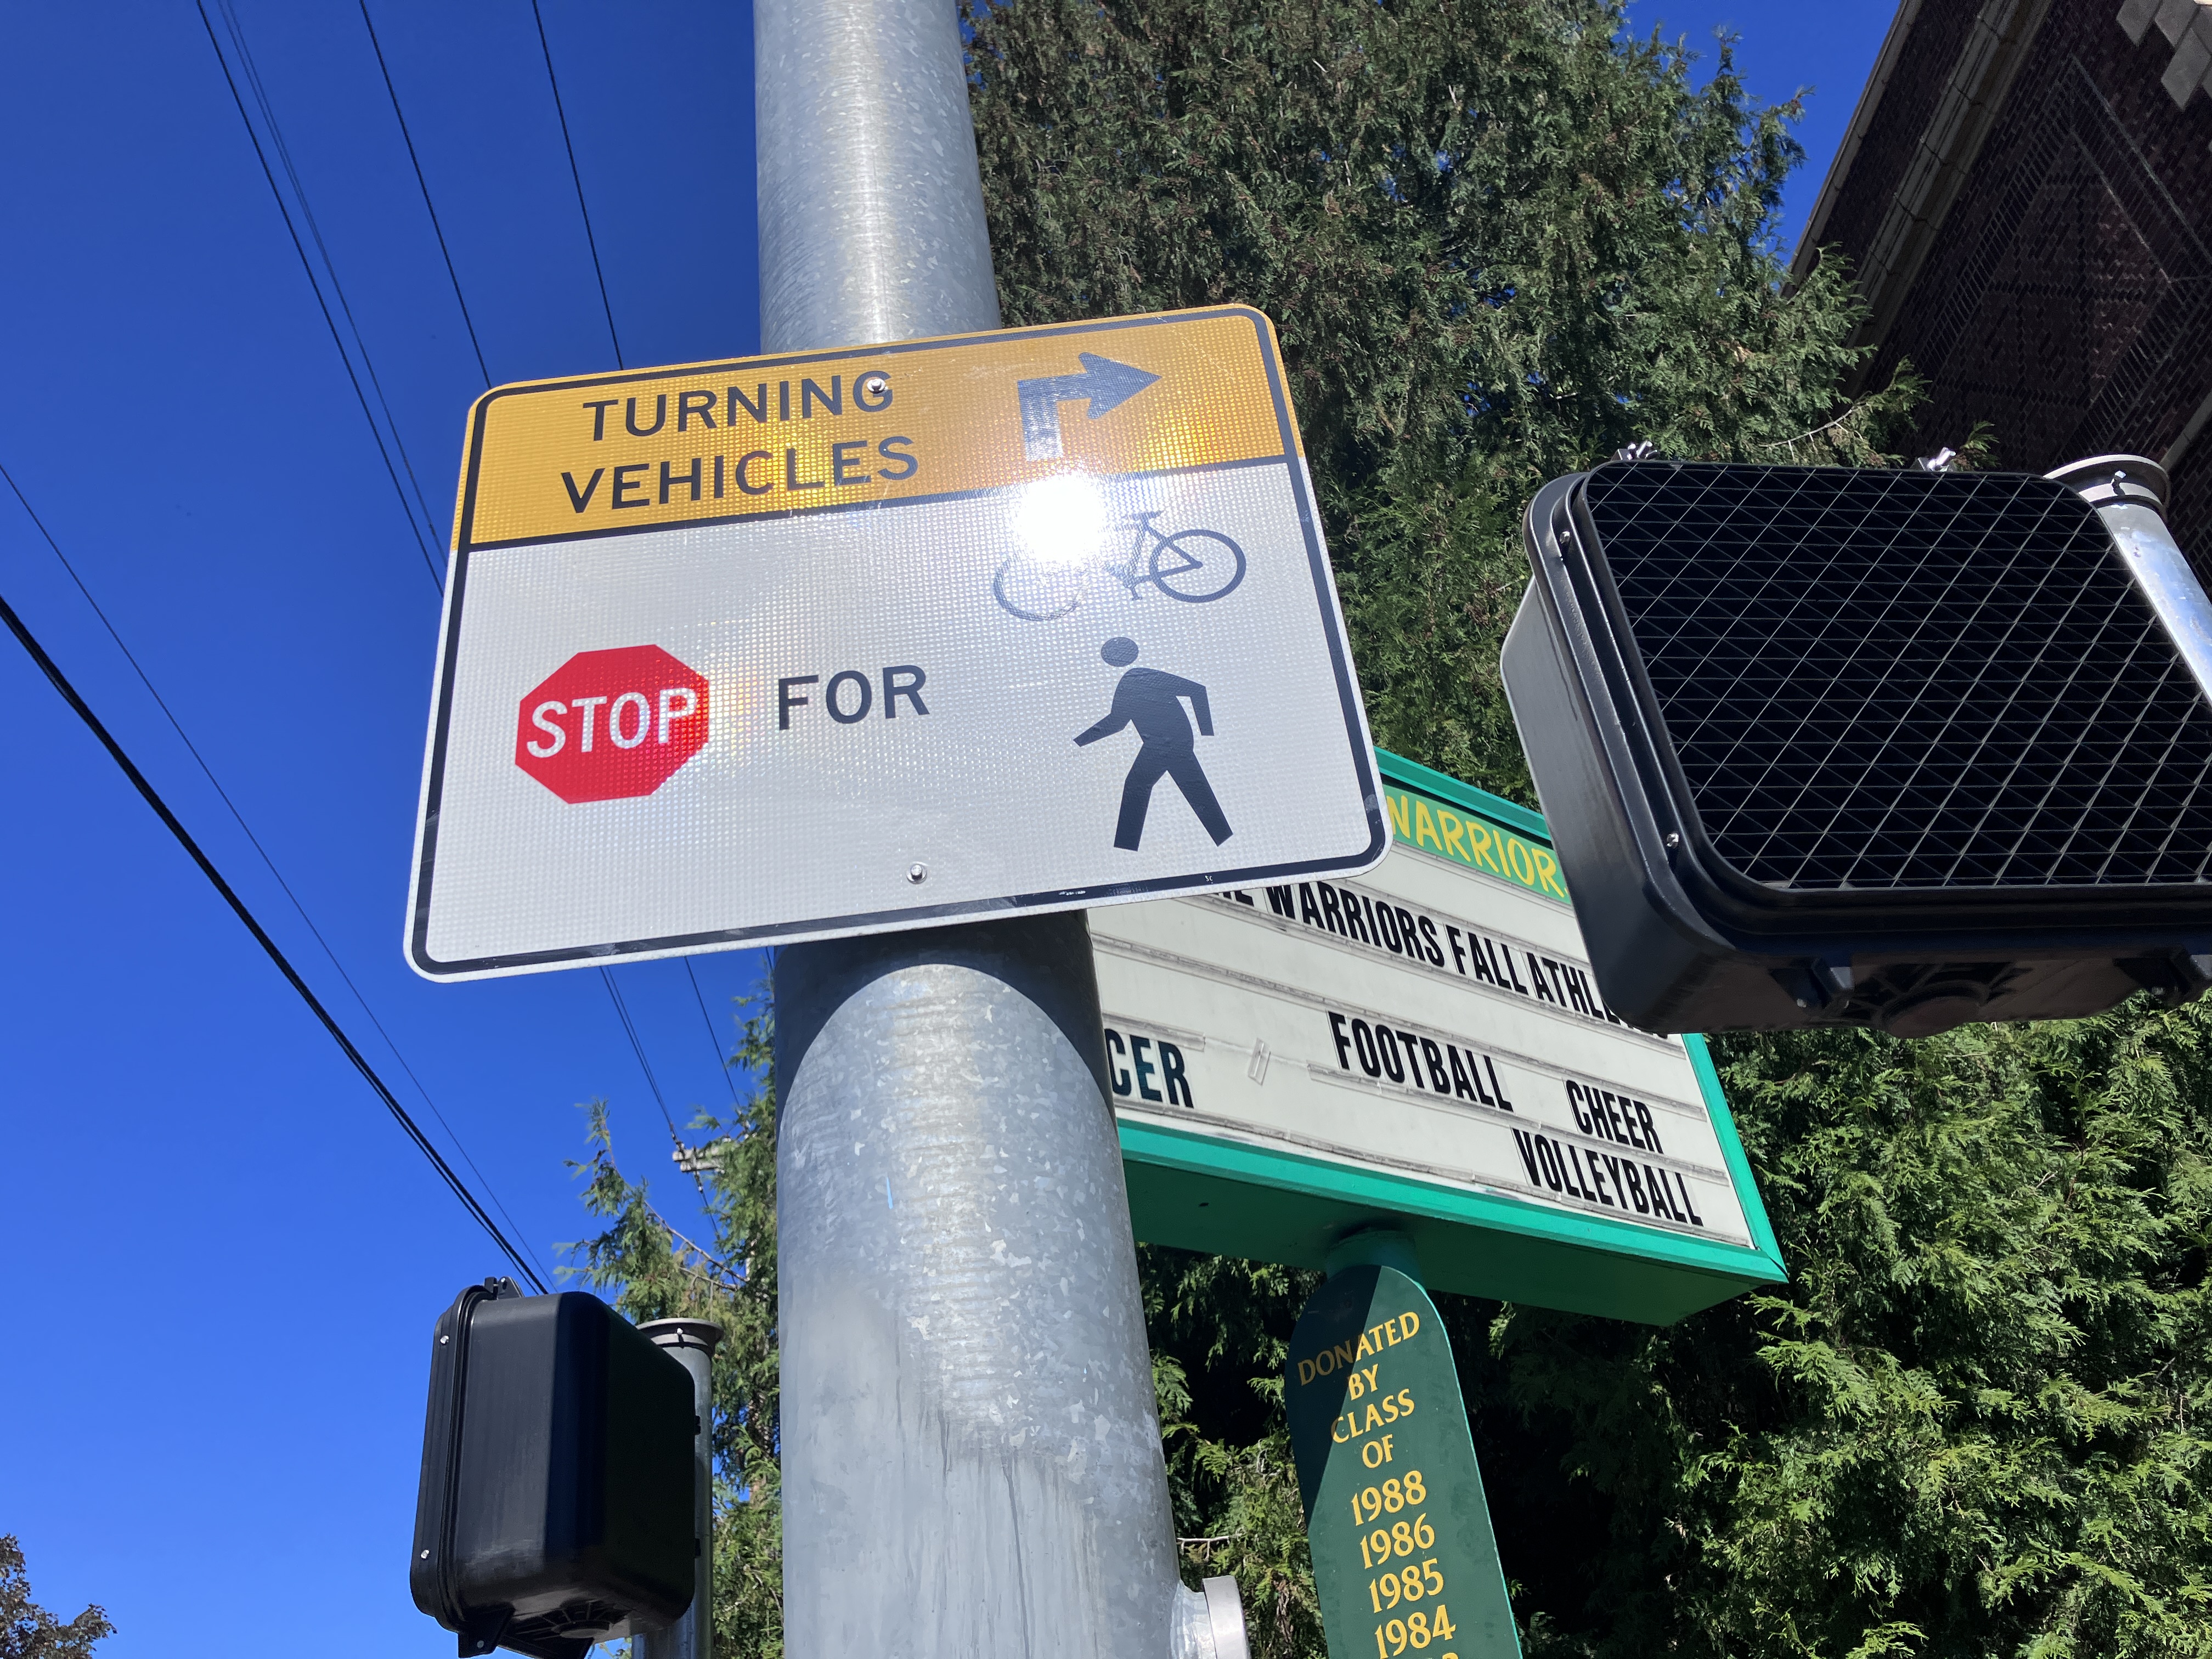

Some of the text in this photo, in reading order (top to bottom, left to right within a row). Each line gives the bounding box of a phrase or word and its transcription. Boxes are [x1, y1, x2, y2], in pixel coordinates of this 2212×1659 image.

[583, 370, 894, 441] TURNING
[561, 436, 918, 514] VEHICLES
[526, 664, 929, 759] STOP FOR
[1386, 795, 1568, 898] WARRIOR
[1266, 881, 1445, 968] WARRIORS
[1446, 924, 1529, 996] FALL
[1328, 1011, 1515, 1113] FOOTBALL
[1565, 1079, 1664, 1154] CHEER
[1512, 1128, 1705, 1227] VOLLEYBALL
[1297, 1311, 1420, 1386] DONATED
[1348, 1363, 1379, 1401] BY
[1330, 1388, 1415, 1444] CLASS
[1361, 1434, 1394, 1469] OF
[1351, 1470, 1426, 1527] 1988
[1359, 1513, 1435, 1569] 1986
[1368, 1558, 1444, 1614] 1985
[1374, 1604, 1457, 1659] 1984
